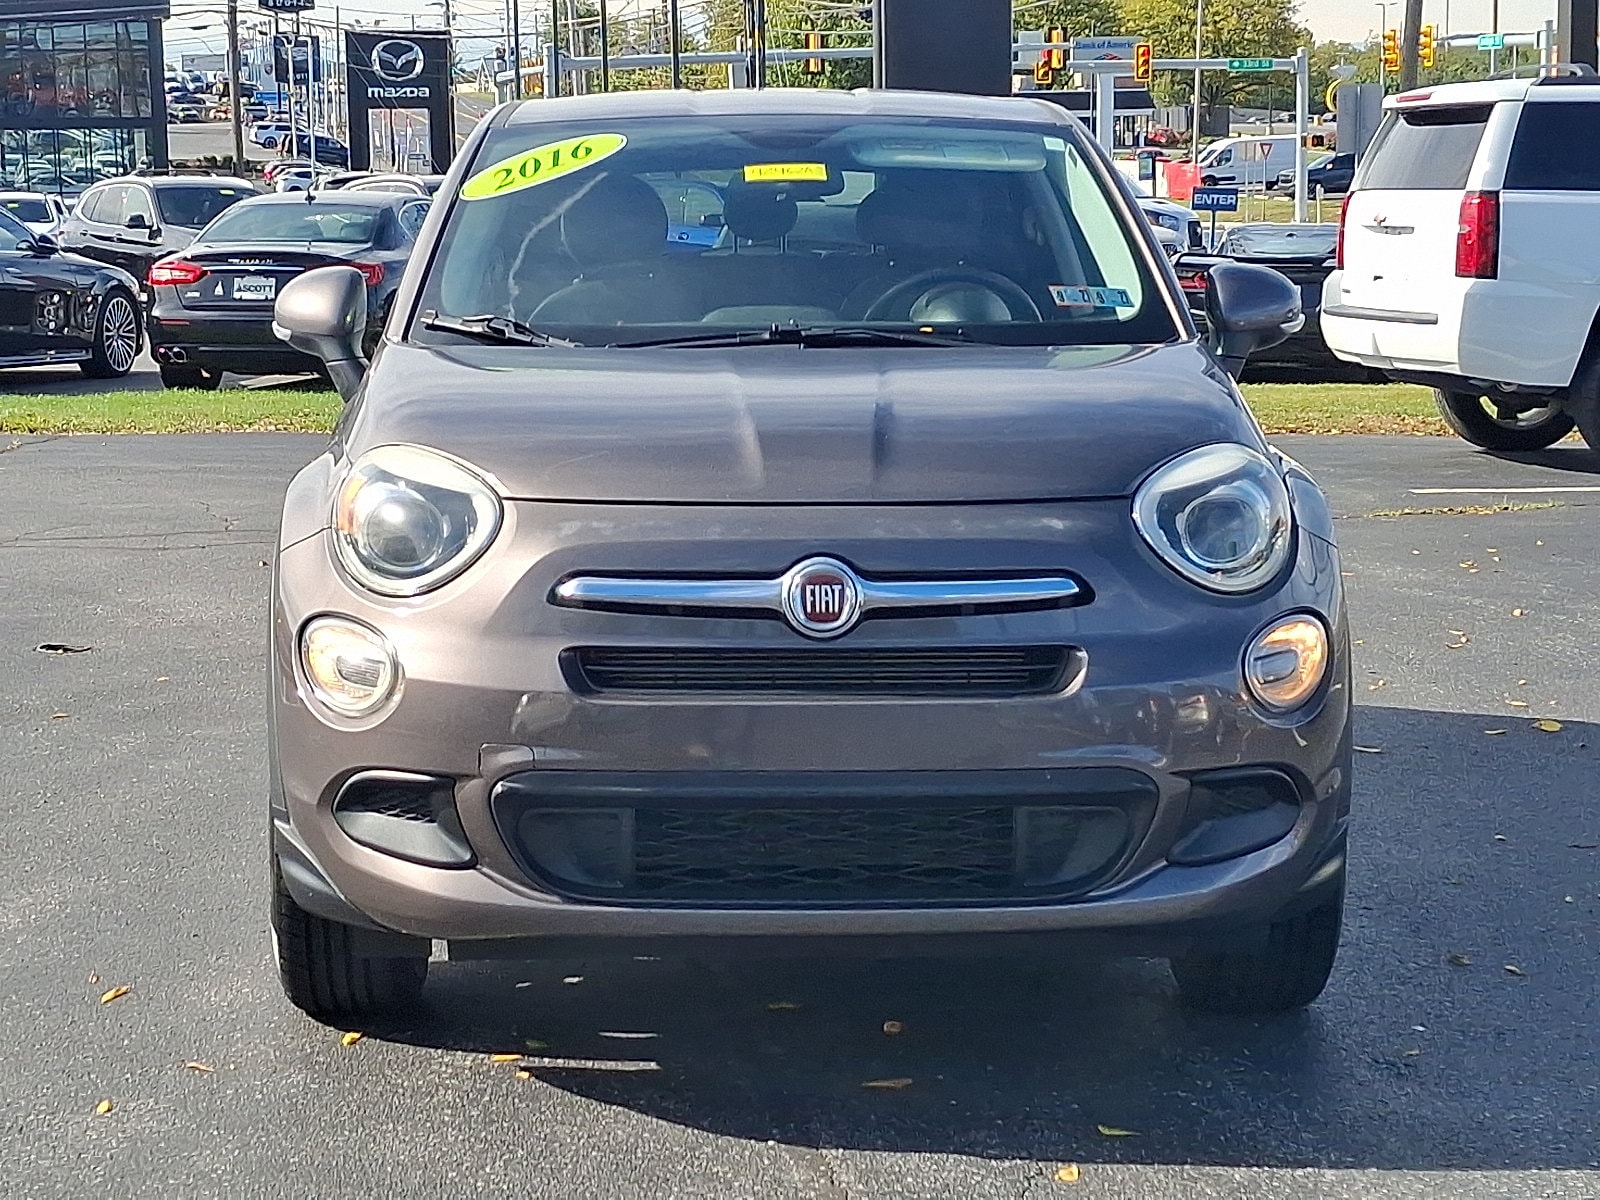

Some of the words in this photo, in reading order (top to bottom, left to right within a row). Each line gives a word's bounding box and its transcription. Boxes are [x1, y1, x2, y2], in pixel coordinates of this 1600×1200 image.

[367, 87, 430, 98] mazda
[493, 139, 593, 191] 2016
[1194, 194, 1237, 205] ENTER
[805, 584, 842, 614] FIAT
